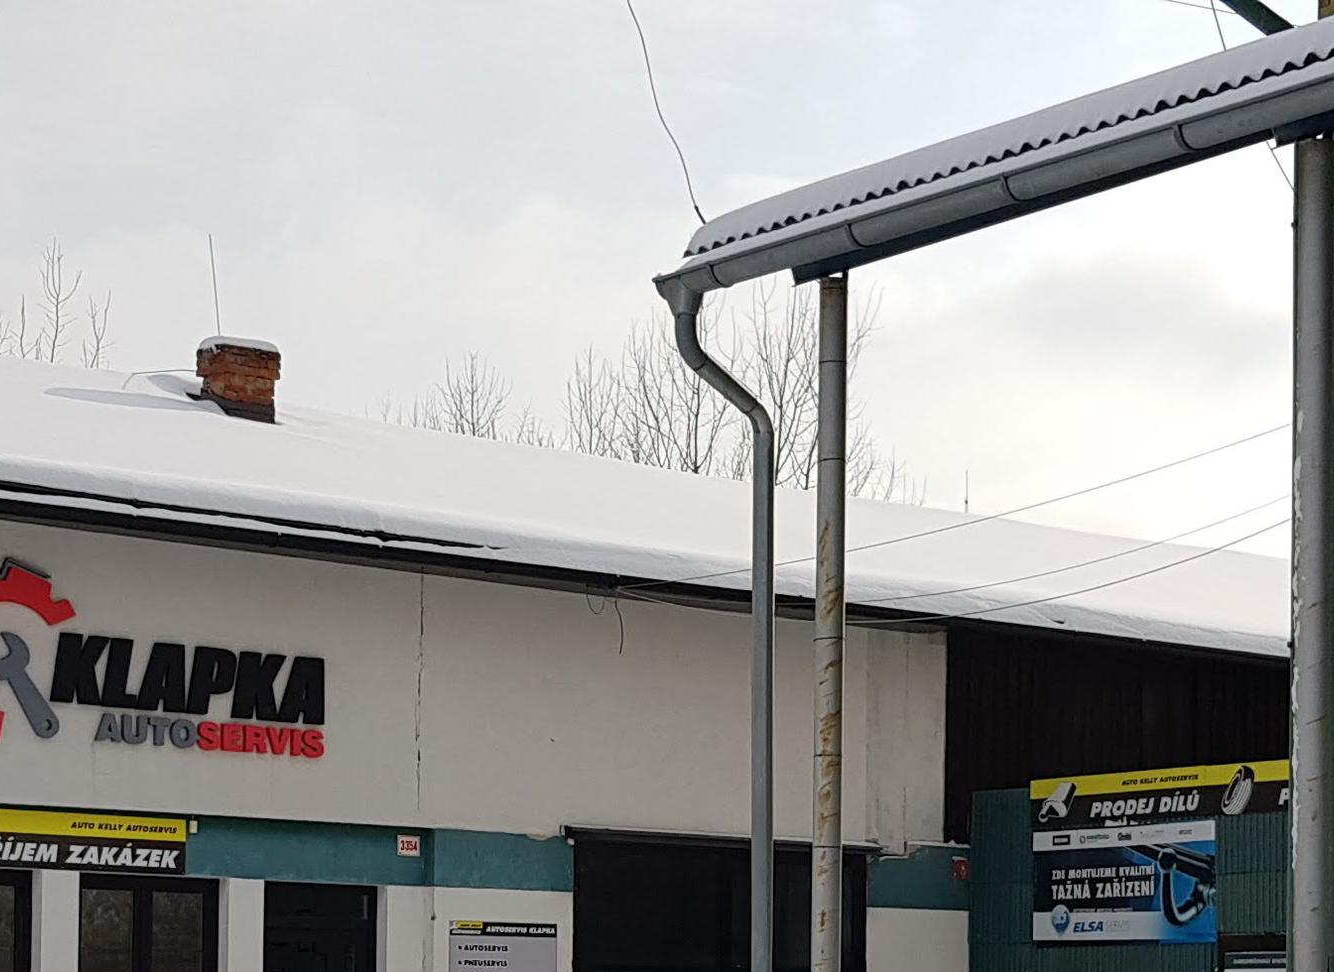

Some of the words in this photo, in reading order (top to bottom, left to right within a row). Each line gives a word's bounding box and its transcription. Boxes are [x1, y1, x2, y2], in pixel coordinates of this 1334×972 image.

[50, 632, 325, 725] KLAPKA
[95, 713, 325, 758] AUTOSERVIS
[1090, 798, 1155, 818] PRODEJ
[1159, 790, 1200, 814] DÍLŮ
[71, 821, 95, 830] AUTO
[98, 824, 123, 832] KELLY
[126, 826, 178, 835] AUTOSERVIS
[65, 842, 179, 869] ZAKÁZEK
[1052, 869, 1066, 880] ZDE
[1068, 867, 1117, 879] MONTUJEME
[1119, 863, 1155, 876] KVALITNÍ
[1051, 880, 1091, 900] TAŽNÁ
[1095, 876, 1155, 899] ZAŘÍZENÍ
[1073, 921, 1104, 933] ELSA
